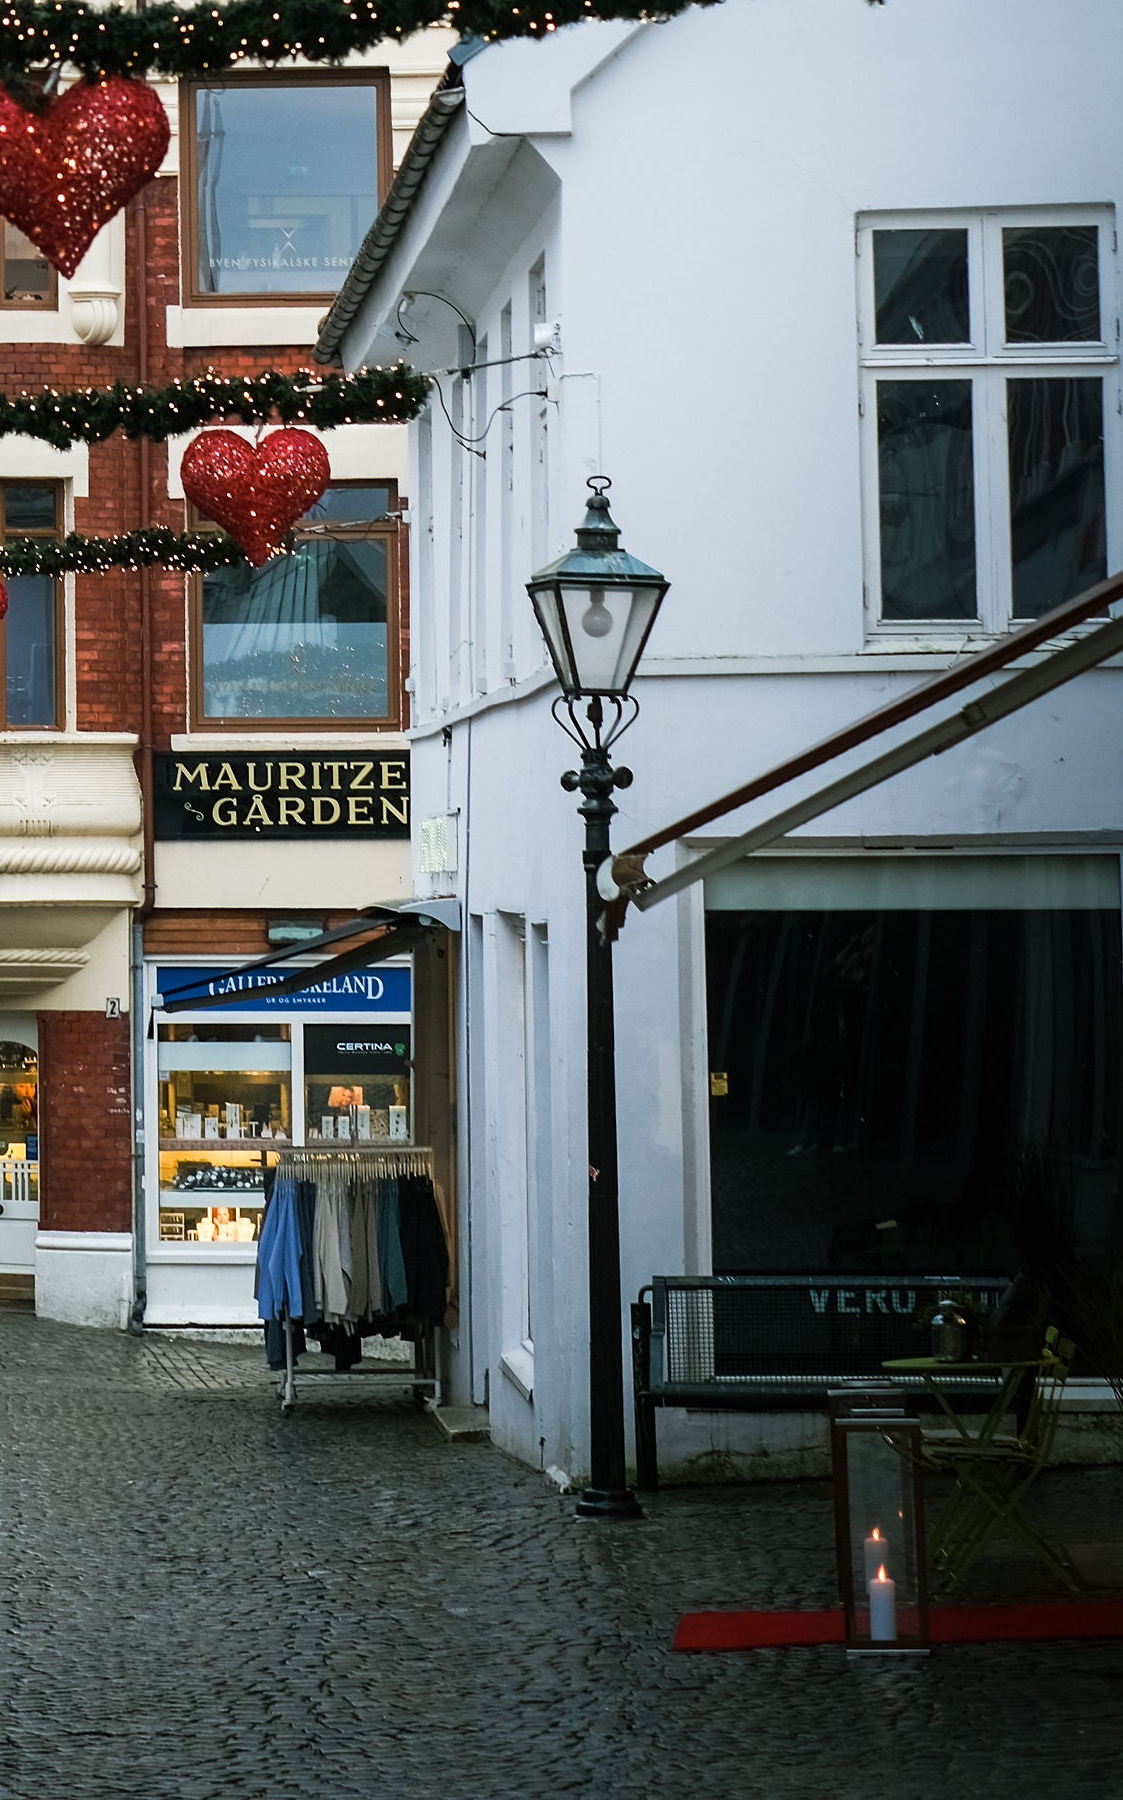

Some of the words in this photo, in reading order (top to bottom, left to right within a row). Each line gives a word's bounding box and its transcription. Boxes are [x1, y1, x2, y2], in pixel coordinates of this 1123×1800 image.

[209, 257, 240, 268] BYEN
[324, 257, 355, 267] SENT
[172, 761, 407, 792] MAURITZE
[211, 794, 409, 826] GÅRDEN
[109, 1000, 117, 1015] 2
[336, 1042, 394, 1051] CERTINA
